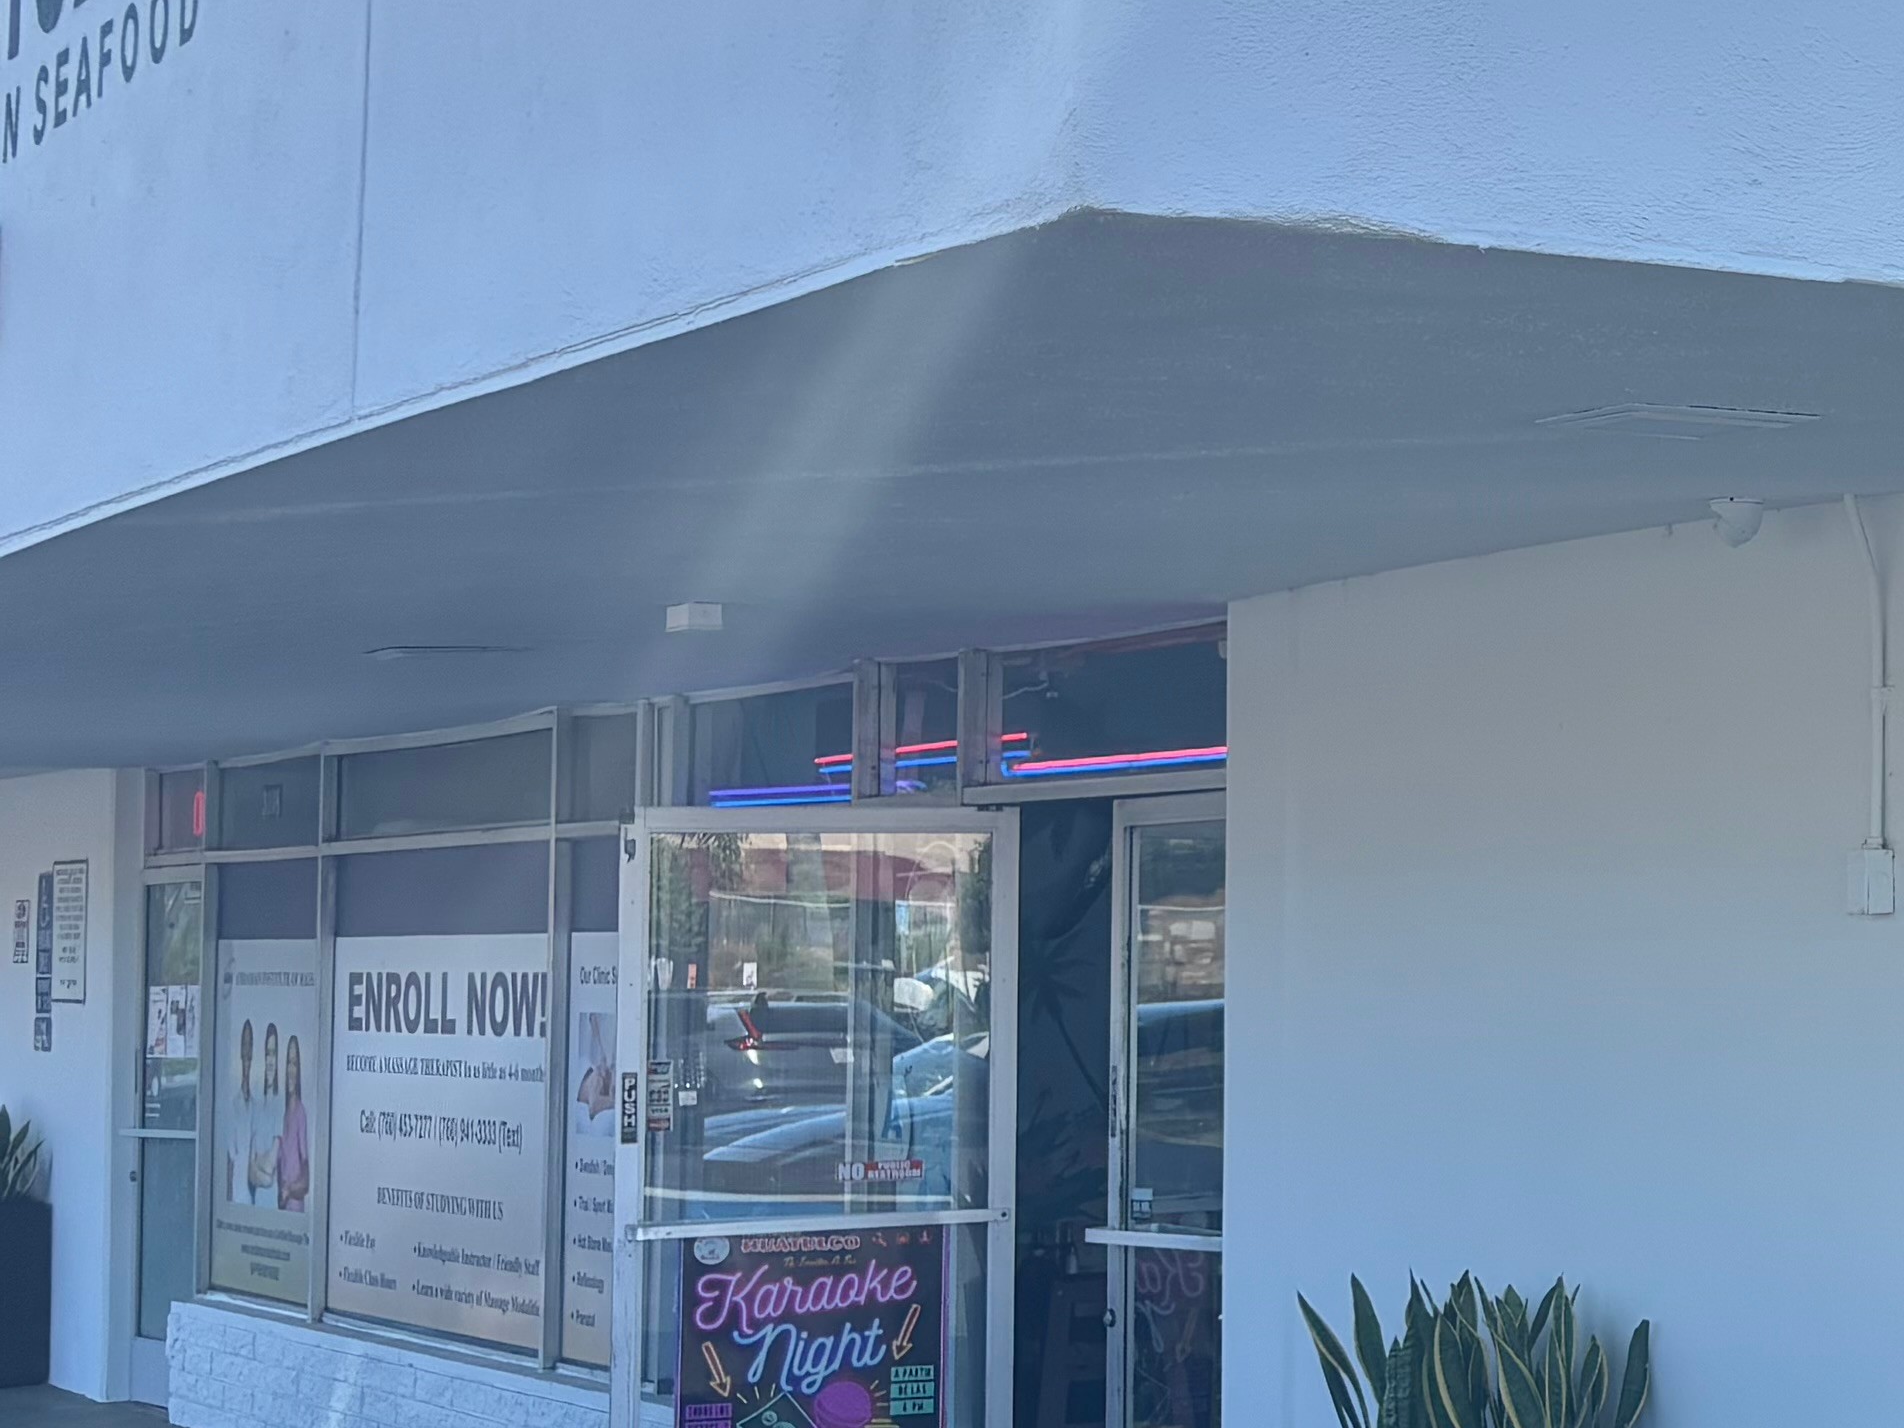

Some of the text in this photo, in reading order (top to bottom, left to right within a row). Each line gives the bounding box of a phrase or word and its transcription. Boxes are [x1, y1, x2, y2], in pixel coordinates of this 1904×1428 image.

[348, 971, 548, 1038] ENROLL NOW!
[623, 1077, 636, 1127] PUSH
[837, 1161, 866, 1182] NO
[377, 1186, 413, 1209] BENEFITS
[425, 1192, 467, 1216] STUDYING
[467, 1197, 492, 1220] WITH
[740, 1234, 860, 1254] HUATULCO
[695, 1258, 918, 1336] Karaoke
[732, 1317, 888, 1396] Night
